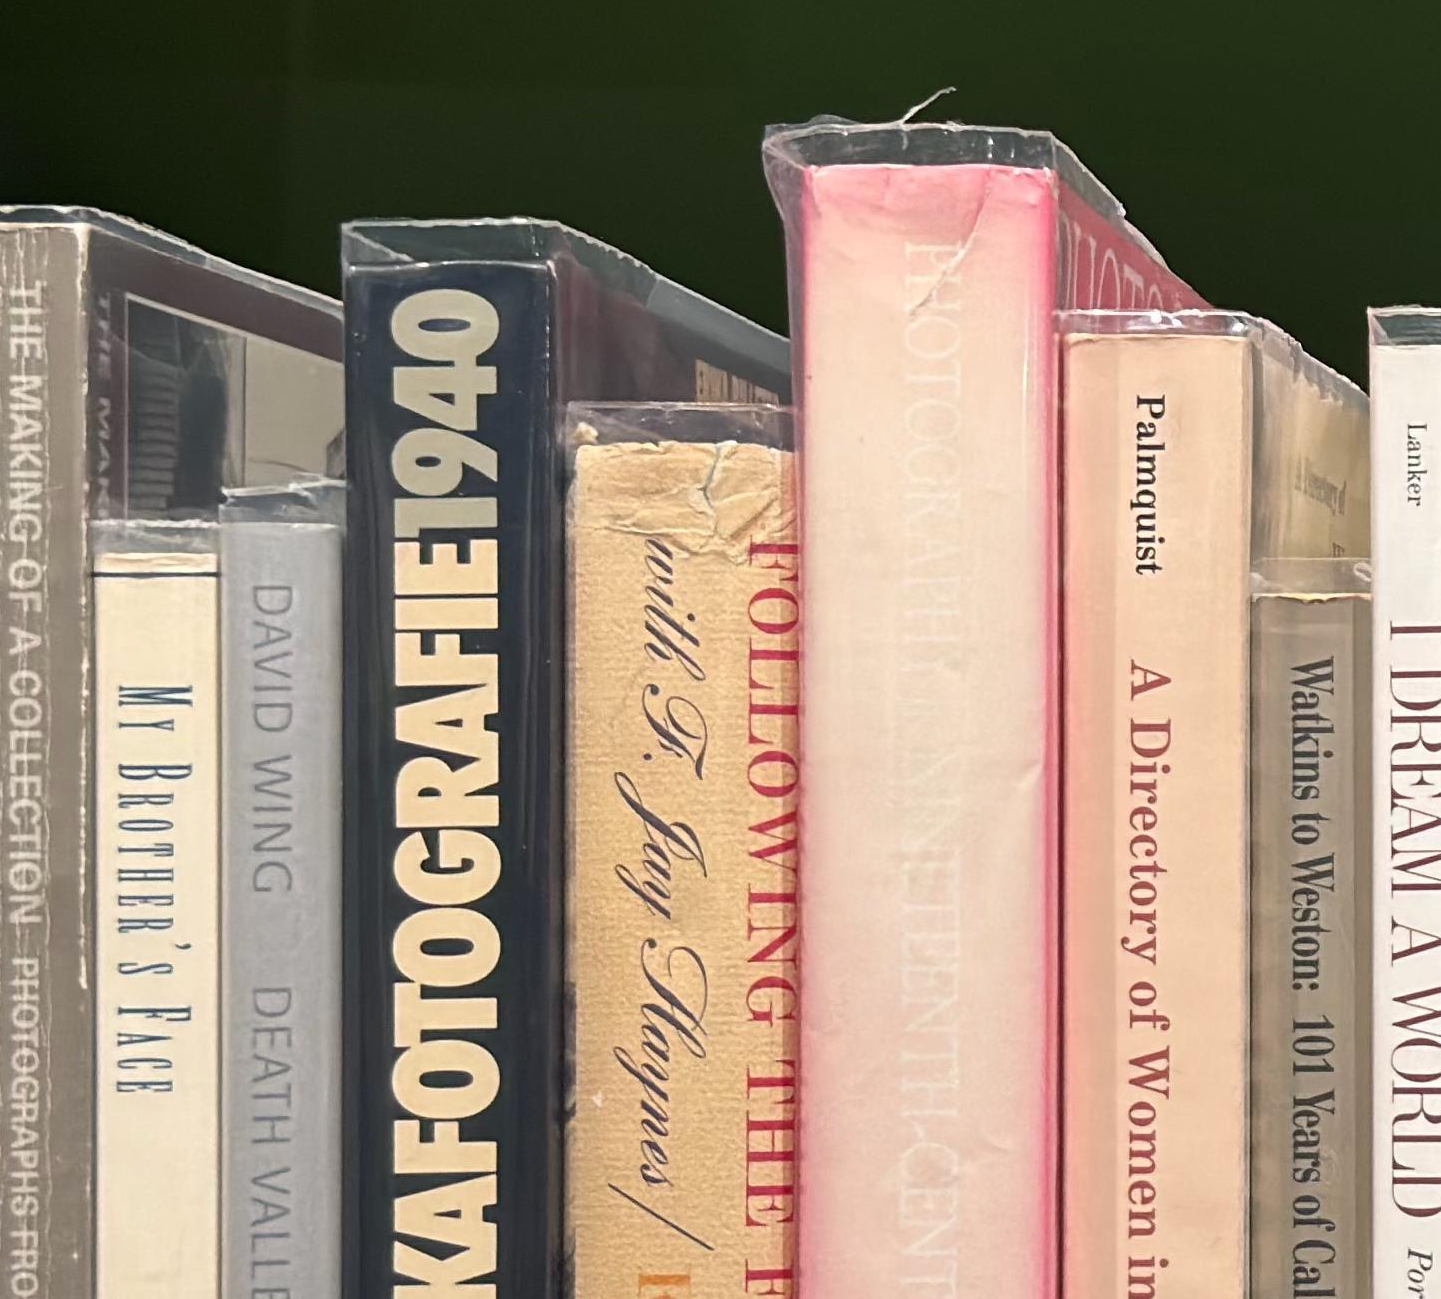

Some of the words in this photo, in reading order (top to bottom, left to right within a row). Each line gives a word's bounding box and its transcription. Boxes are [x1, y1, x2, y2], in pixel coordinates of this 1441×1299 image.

[1133, 394, 1166, 575] Palmquist
[1405, 422, 1429, 506] Lanker
[251, 585, 294, 733] DAVID
[1129, 659, 1172, 699] A
[250, 756, 294, 895] WING
[745, 539, 800, 1026] FOLLOWING
[1120, 717, 1172, 965] Directory
[1129, 979, 1172, 1031] of
[742, 1059, 798, 1227] THE
[1127, 1046, 1170, 1238] Women
